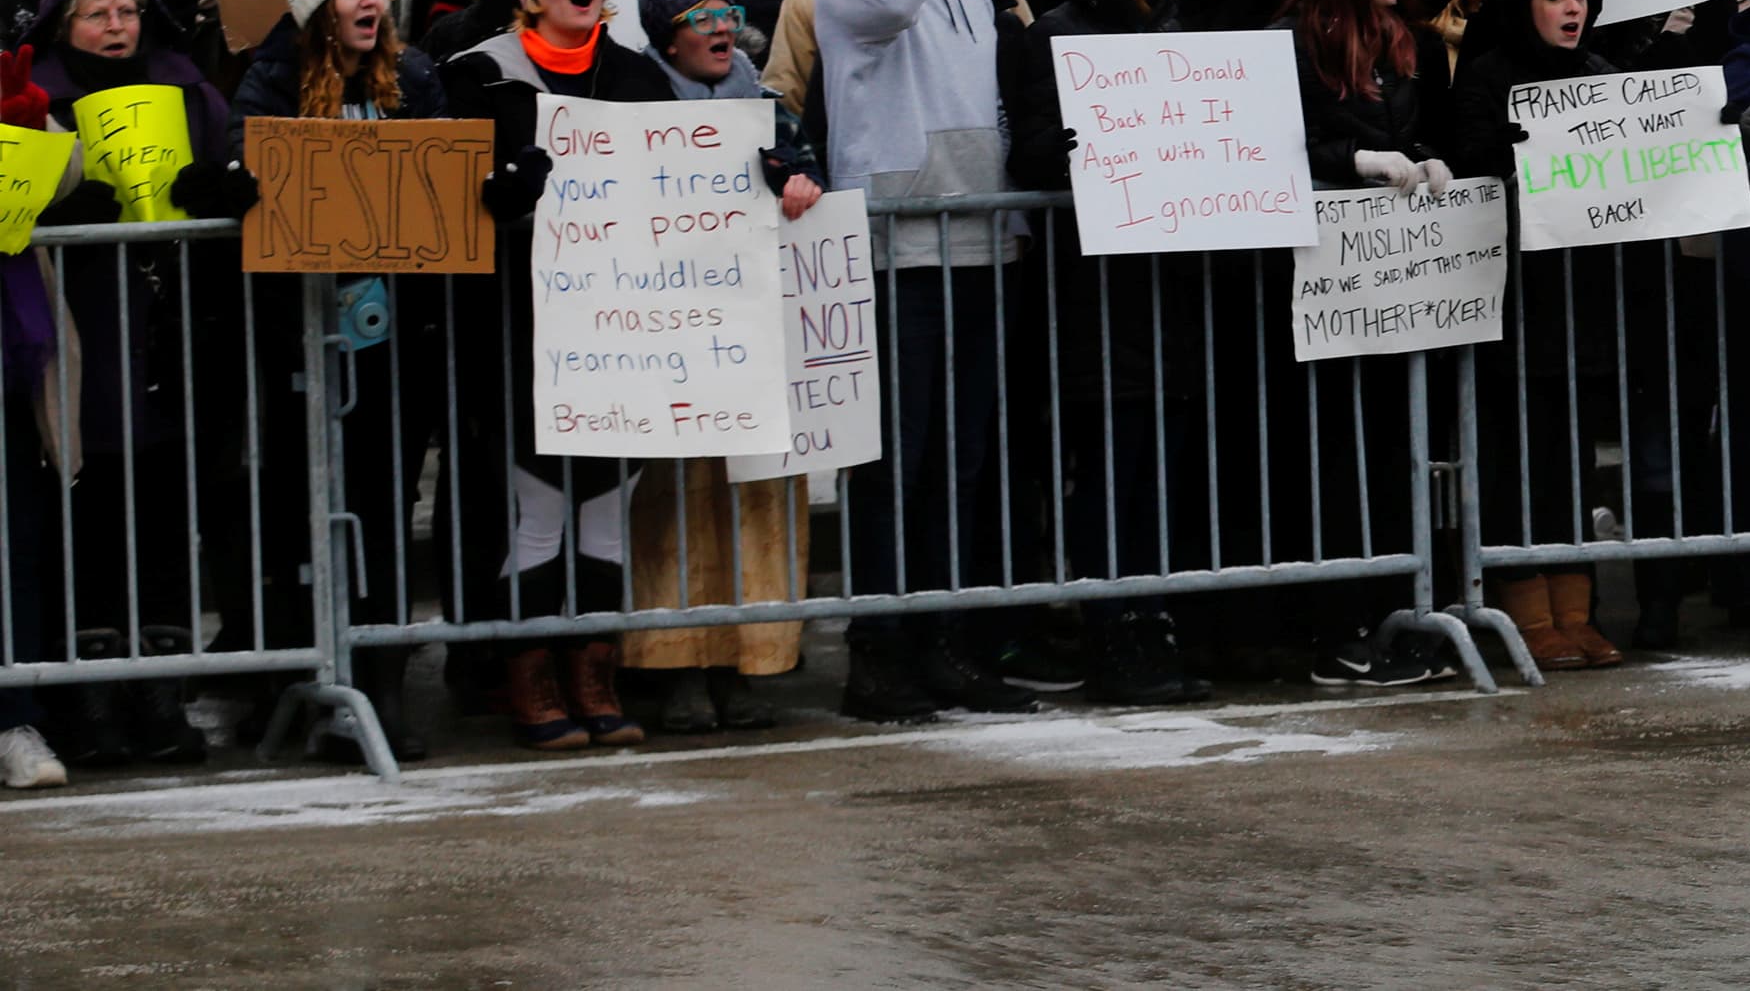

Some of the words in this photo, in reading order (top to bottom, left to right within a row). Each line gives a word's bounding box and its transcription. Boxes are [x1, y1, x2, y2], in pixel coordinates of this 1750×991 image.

[1061, 50, 1148, 92] Damn
[1157, 48, 1248, 83] Donald
[1089, 103, 1146, 133] Back
[1160, 99, 1186, 126] At
[1200, 97, 1234, 125] It
[1510, 82, 1609, 120] FRANCE
[1621, 73, 1702, 105] CALLED,
[548, 105, 614, 157] Give
[644, 123, 722, 151] me
[1567, 117, 1628, 146] THEY
[1637, 109, 1687, 134] WANT
[1082, 141, 1138, 179] Again
[1217, 137, 1267, 163] The
[1522, 147, 1614, 193] LADY
[1621, 135, 1743, 186] LIBERTY
[258, 135, 492, 261] RESIST
[550, 179, 618, 215] your
[1109, 173, 1299, 234] Ignorance!
[1315, 198, 1351, 225] RST
[1356, 192, 1398, 222] THEY
[1408, 191, 1447, 215] CAME
[1448, 189, 1474, 209] FOR
[1476, 184, 1501, 204] THE
[1586, 197, 1645, 229] BACK!
[547, 219, 618, 263] your
[1339, 220, 1444, 266] MUSLIMS
[538, 268, 596, 304] your
[611, 253, 742, 292] huddled
[1300, 276, 1334, 299] AND
[1338, 273, 1362, 293] WE
[1405, 259, 1431, 280] NOT
[1431, 252, 1463, 275] THIS
[1466, 245, 1502, 261] TIME
[594, 306, 724, 333] masses
[799, 298, 872, 353] NOT
[546, 347, 688, 386] yearning
[707, 334, 747, 369] to
[552, 402, 653, 435] Breathe
[669, 402, 760, 436] Free
